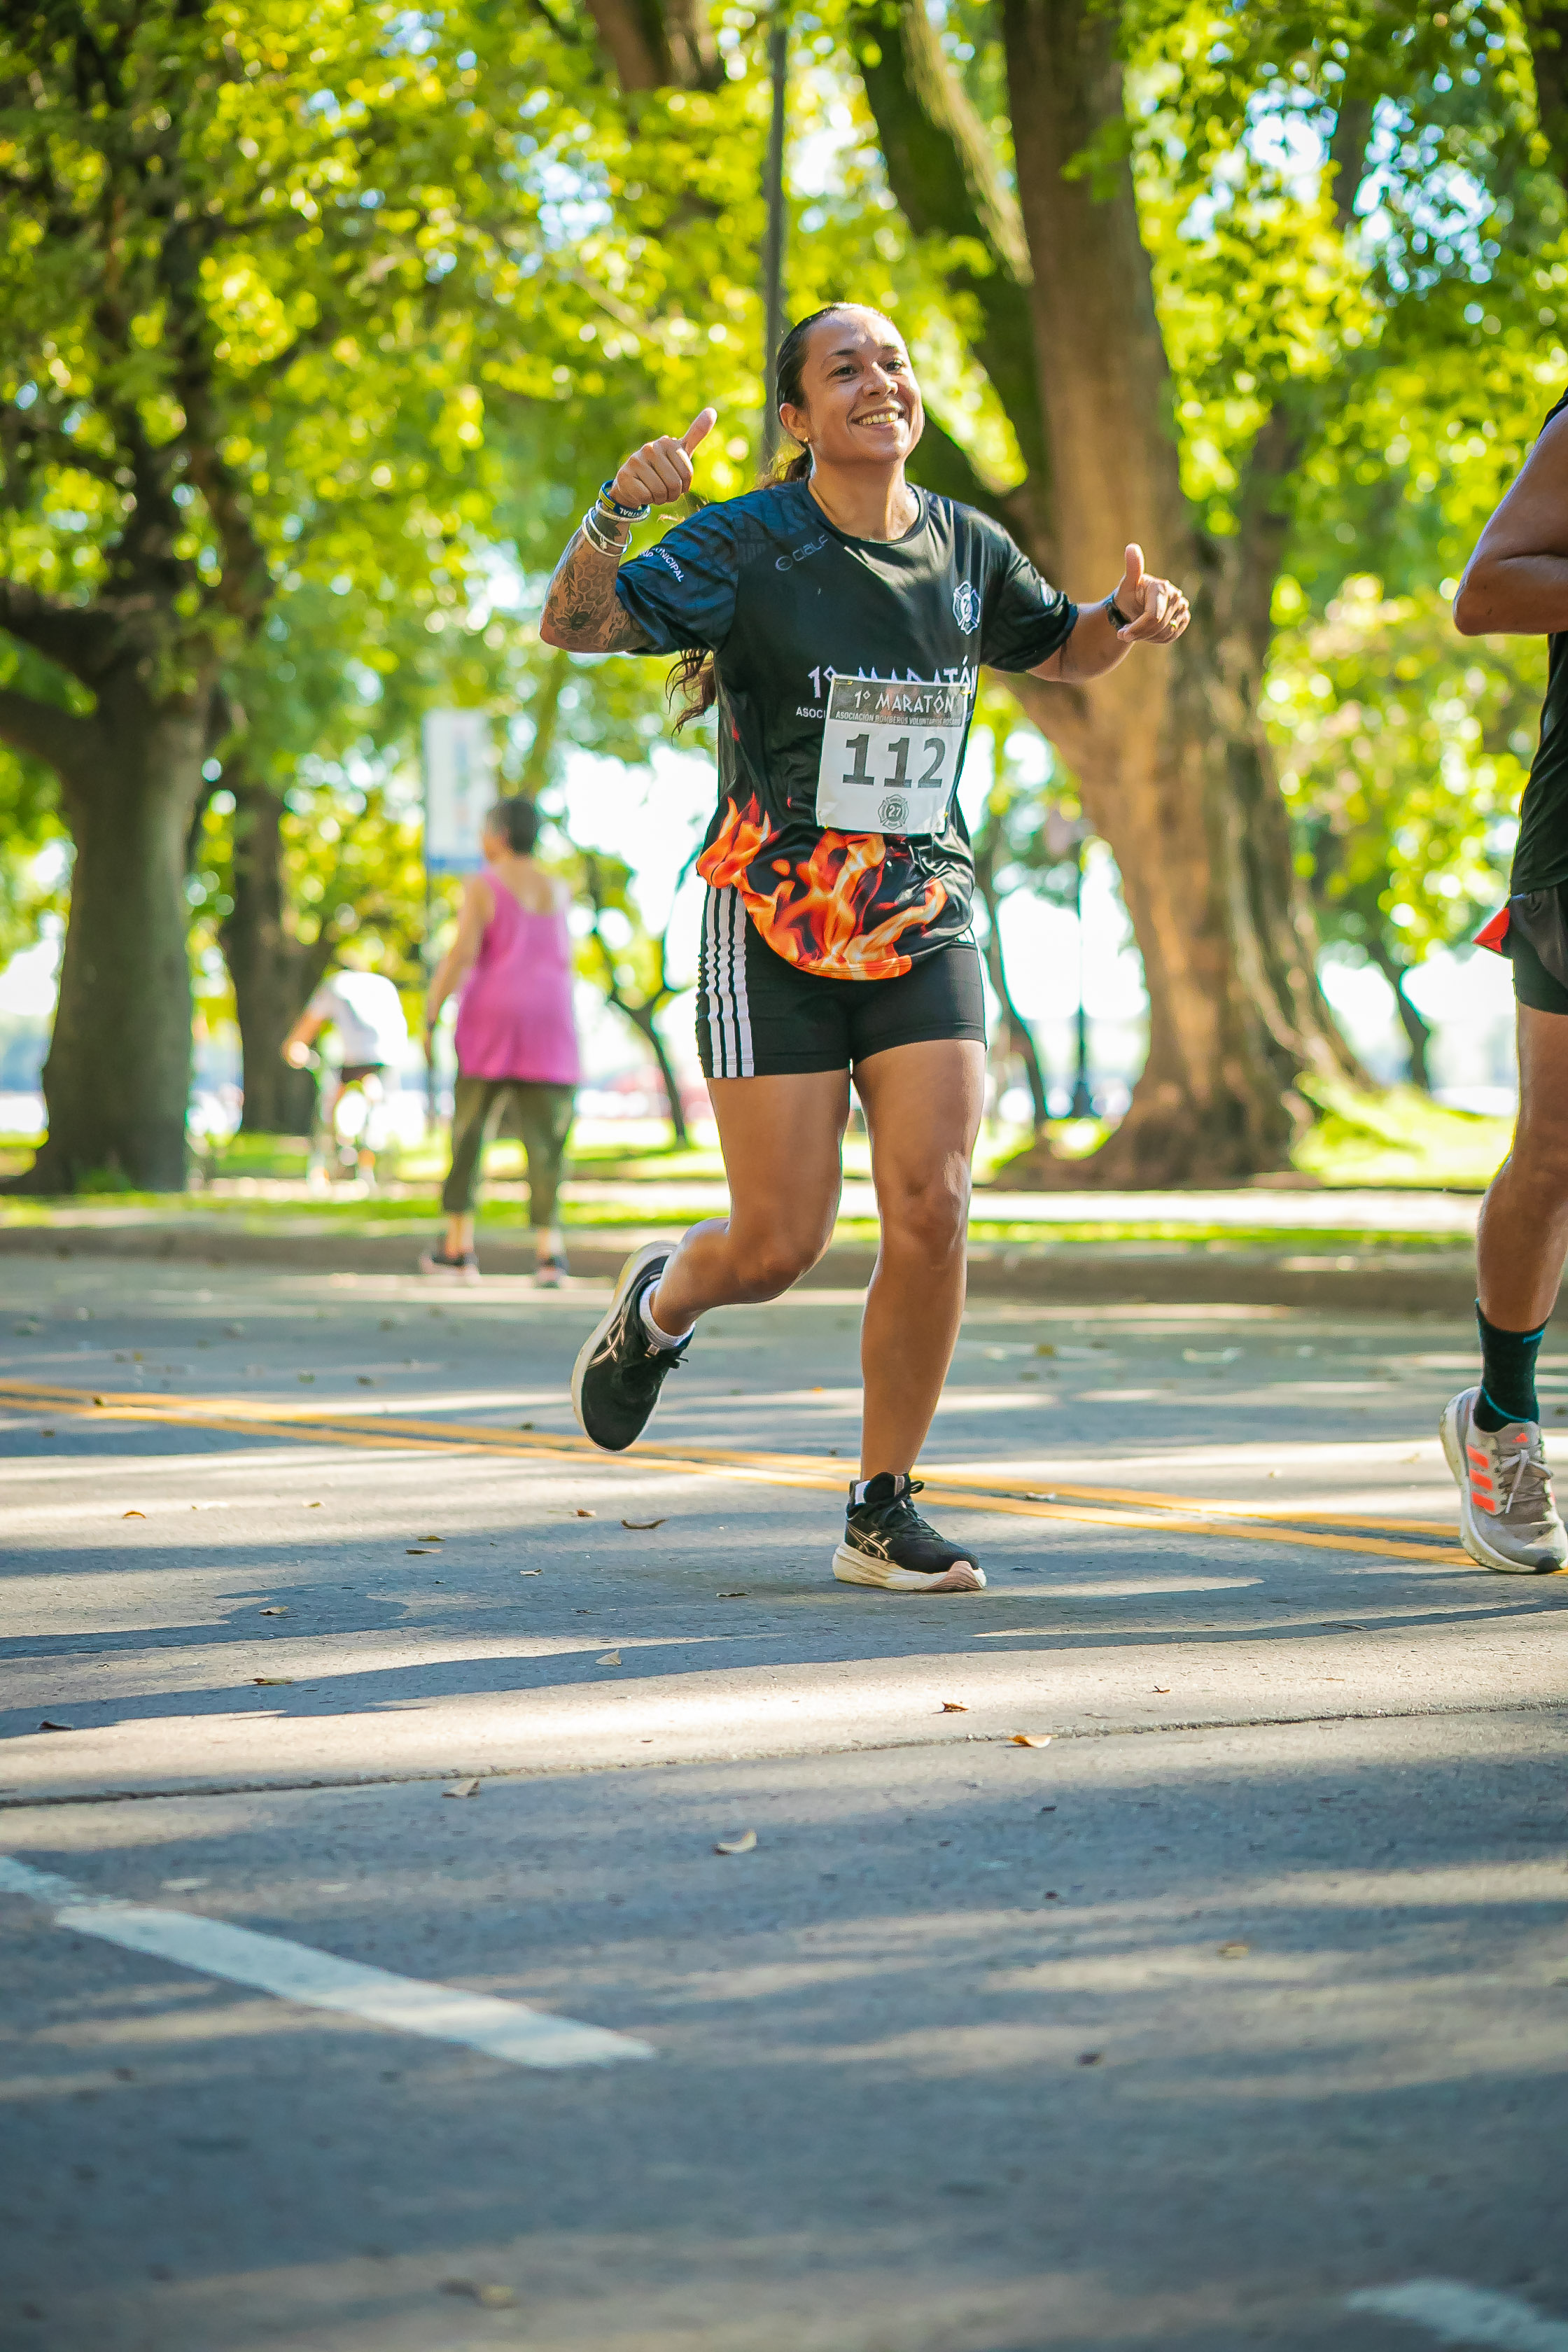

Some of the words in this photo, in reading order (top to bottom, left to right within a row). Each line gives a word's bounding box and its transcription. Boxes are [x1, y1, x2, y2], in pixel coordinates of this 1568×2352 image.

[652, 547, 685, 582] UNICIPAL
[874, 689, 955, 714] MARATÓN
[796, 706, 826, 719] ASOCI
[875, 715, 908, 724] BOMBEROS
[843, 734, 946, 788] 112
[888, 804, 902, 818] 27
